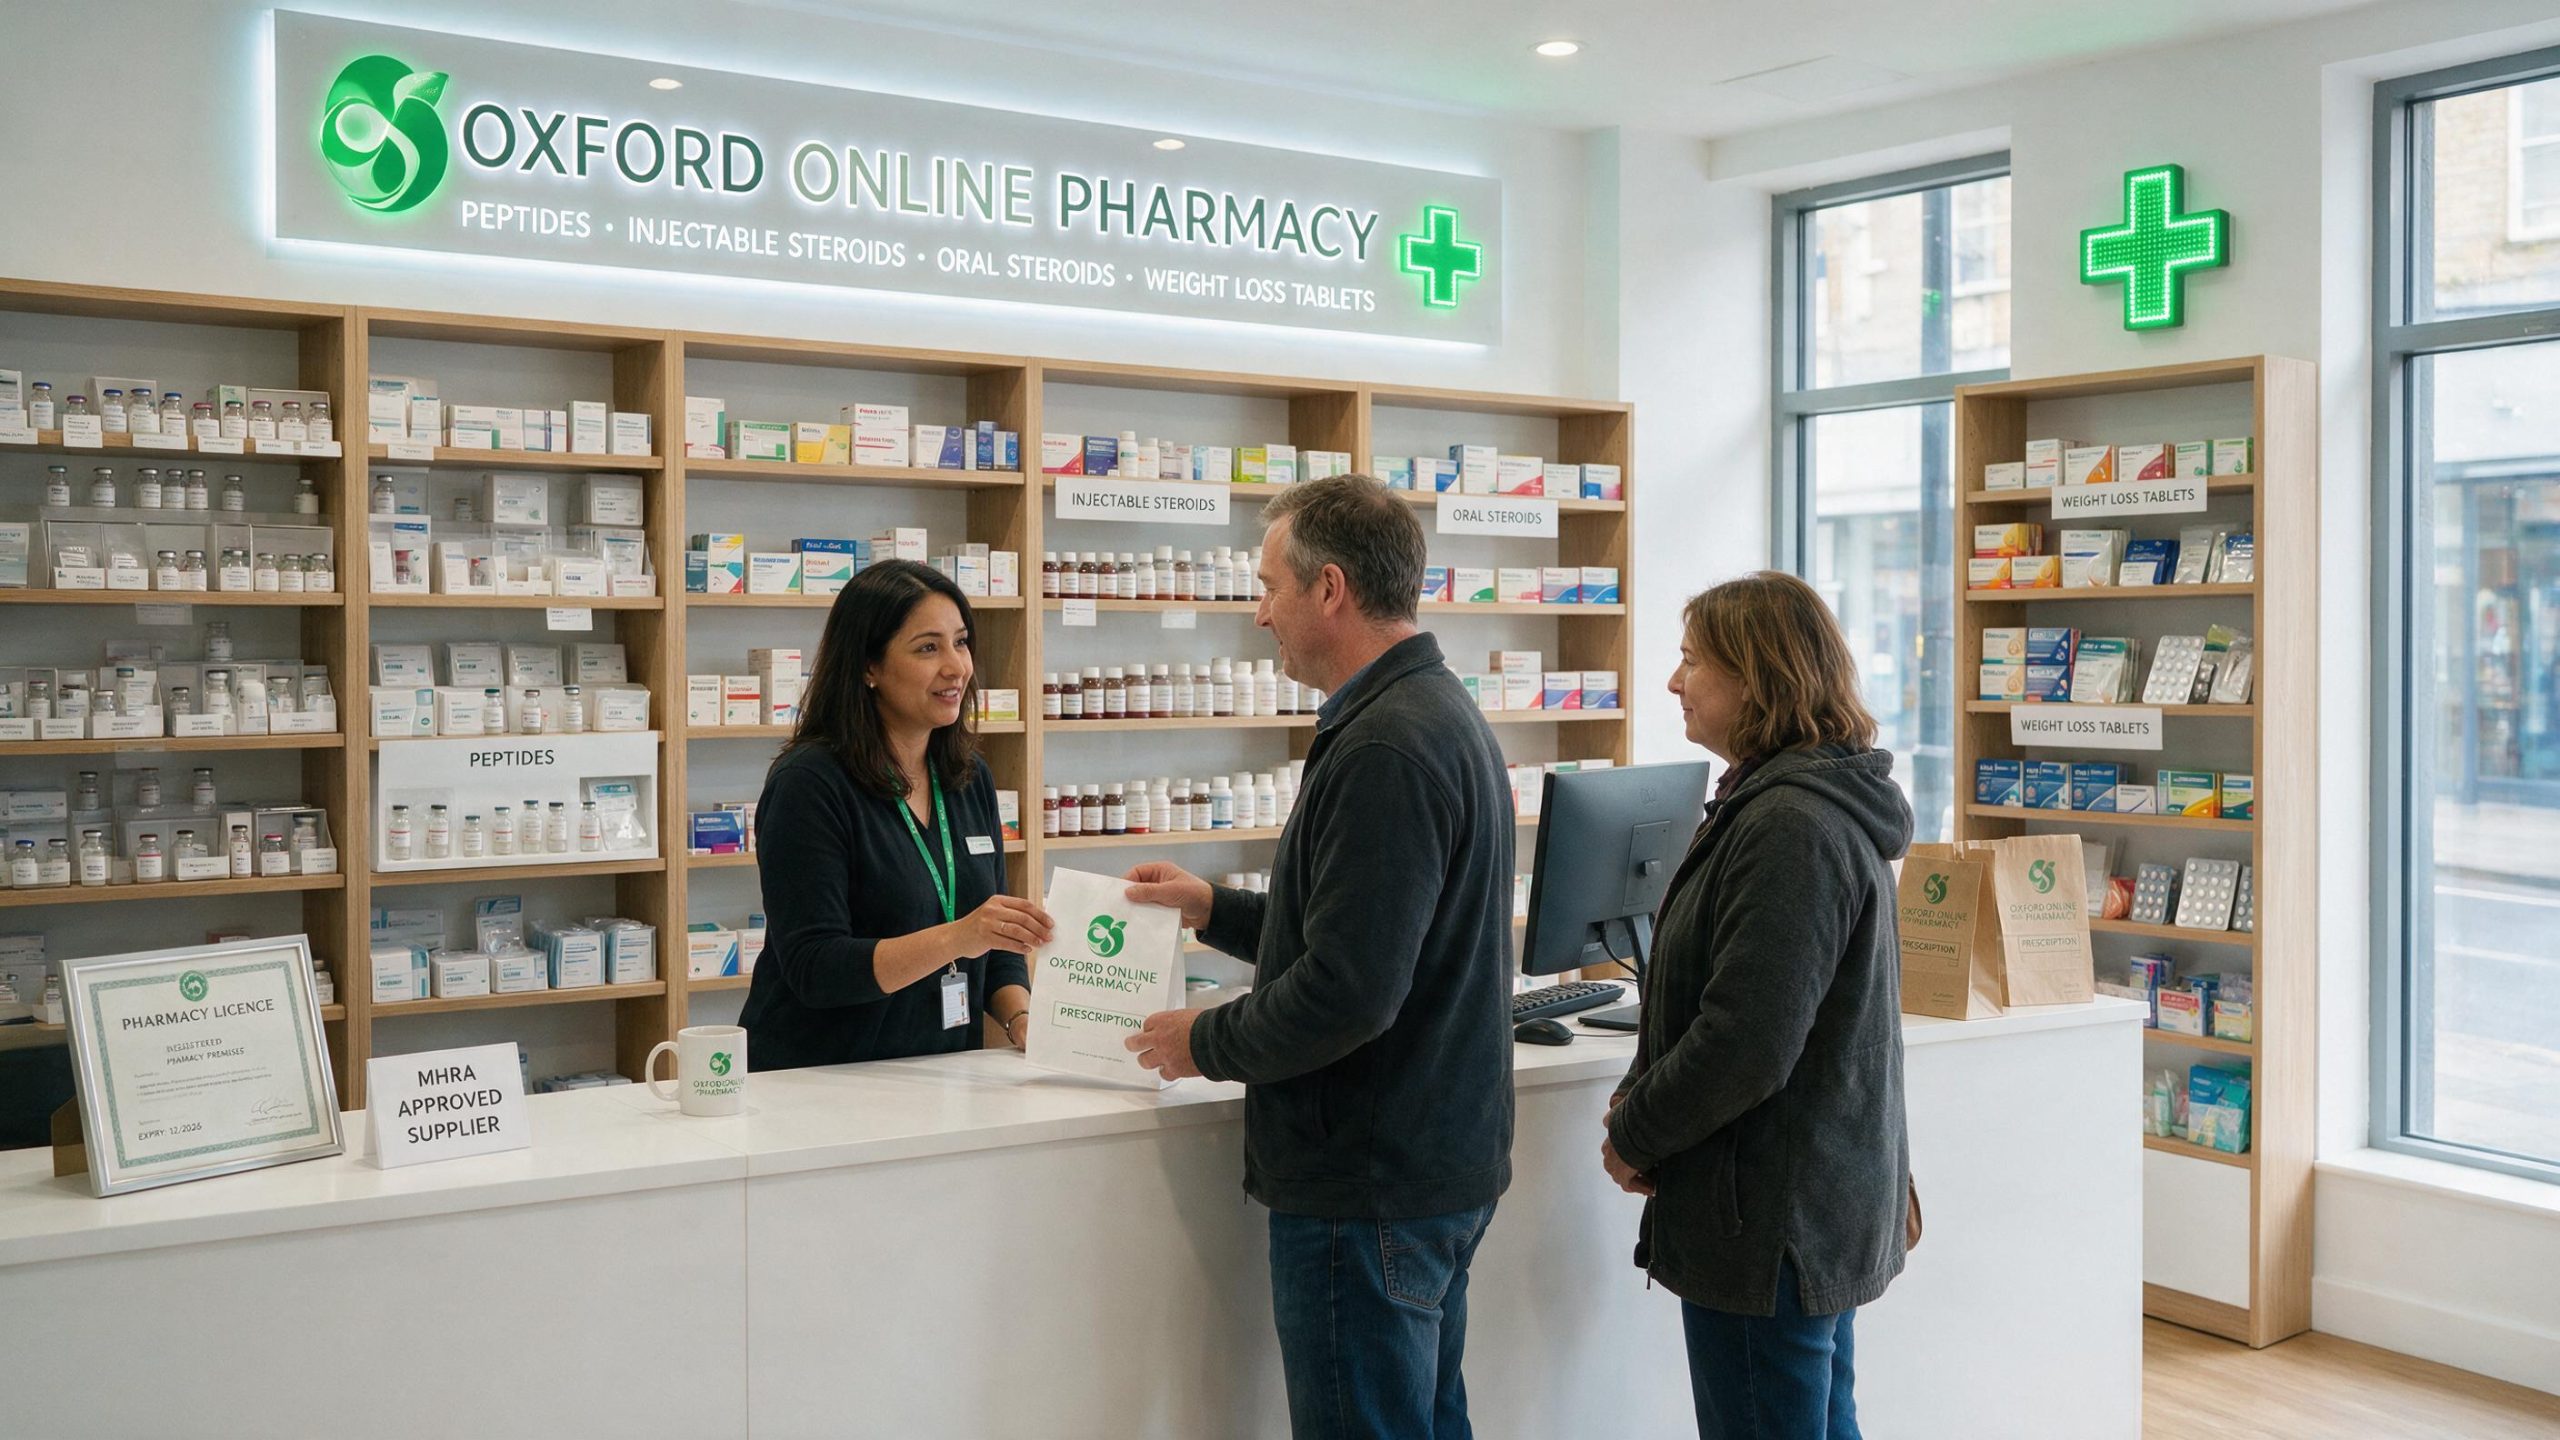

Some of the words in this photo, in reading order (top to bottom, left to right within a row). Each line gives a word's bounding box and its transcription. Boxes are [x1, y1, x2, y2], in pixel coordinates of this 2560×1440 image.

[462, 103, 765, 195] OXFORD
[791, 142, 1034, 225] ONLINE
[1059, 172, 1380, 262] PHARMACY
[461, 200, 592, 239] PEPTIDES
[628, 215, 780, 257] INJECTABLE
[787, 232, 906, 269] STEROIDS
[936, 246, 1000, 276] ORAL
[1006, 253, 1116, 288] STEROIDS
[1144, 266, 1229, 298] WEIGHT
[1235, 276, 1287, 304] LOSS
[1292, 282, 1376, 312] TABLETS
[1071, 492, 1150, 509] INJECTABLE
[1154, 496, 1216, 512] STEROIDS
[2061, 493, 2108, 508] WEIGHT
[2110, 491, 2139, 506] LOSS
[2143, 488, 2195, 504] TABLETS
[1453, 508, 1484, 523] ORAL
[1487, 510, 1542, 525] STEROIDS
[2021, 719, 2064, 733] WEIGHT
[2067, 720, 2096, 734] LOSS
[2099, 721, 2150, 735] TABLETS
[469, 748, 555, 768] PEPTIDES
[1049, 956, 1104, 975] OXFORD
[1107, 964, 1158, 984] ONLINE
[1068, 973, 1142, 994] PHARMACY
[122, 1007, 209, 1031] PHARMACY
[213, 999, 275, 1019] LICENCE
[1060, 1007, 1143, 1030] PRESCRIPTION
[418, 1064, 477, 1088] MHRA
[398, 1088, 503, 1118] APPROVED
[407, 1115, 501, 1144] SUPPLIER
